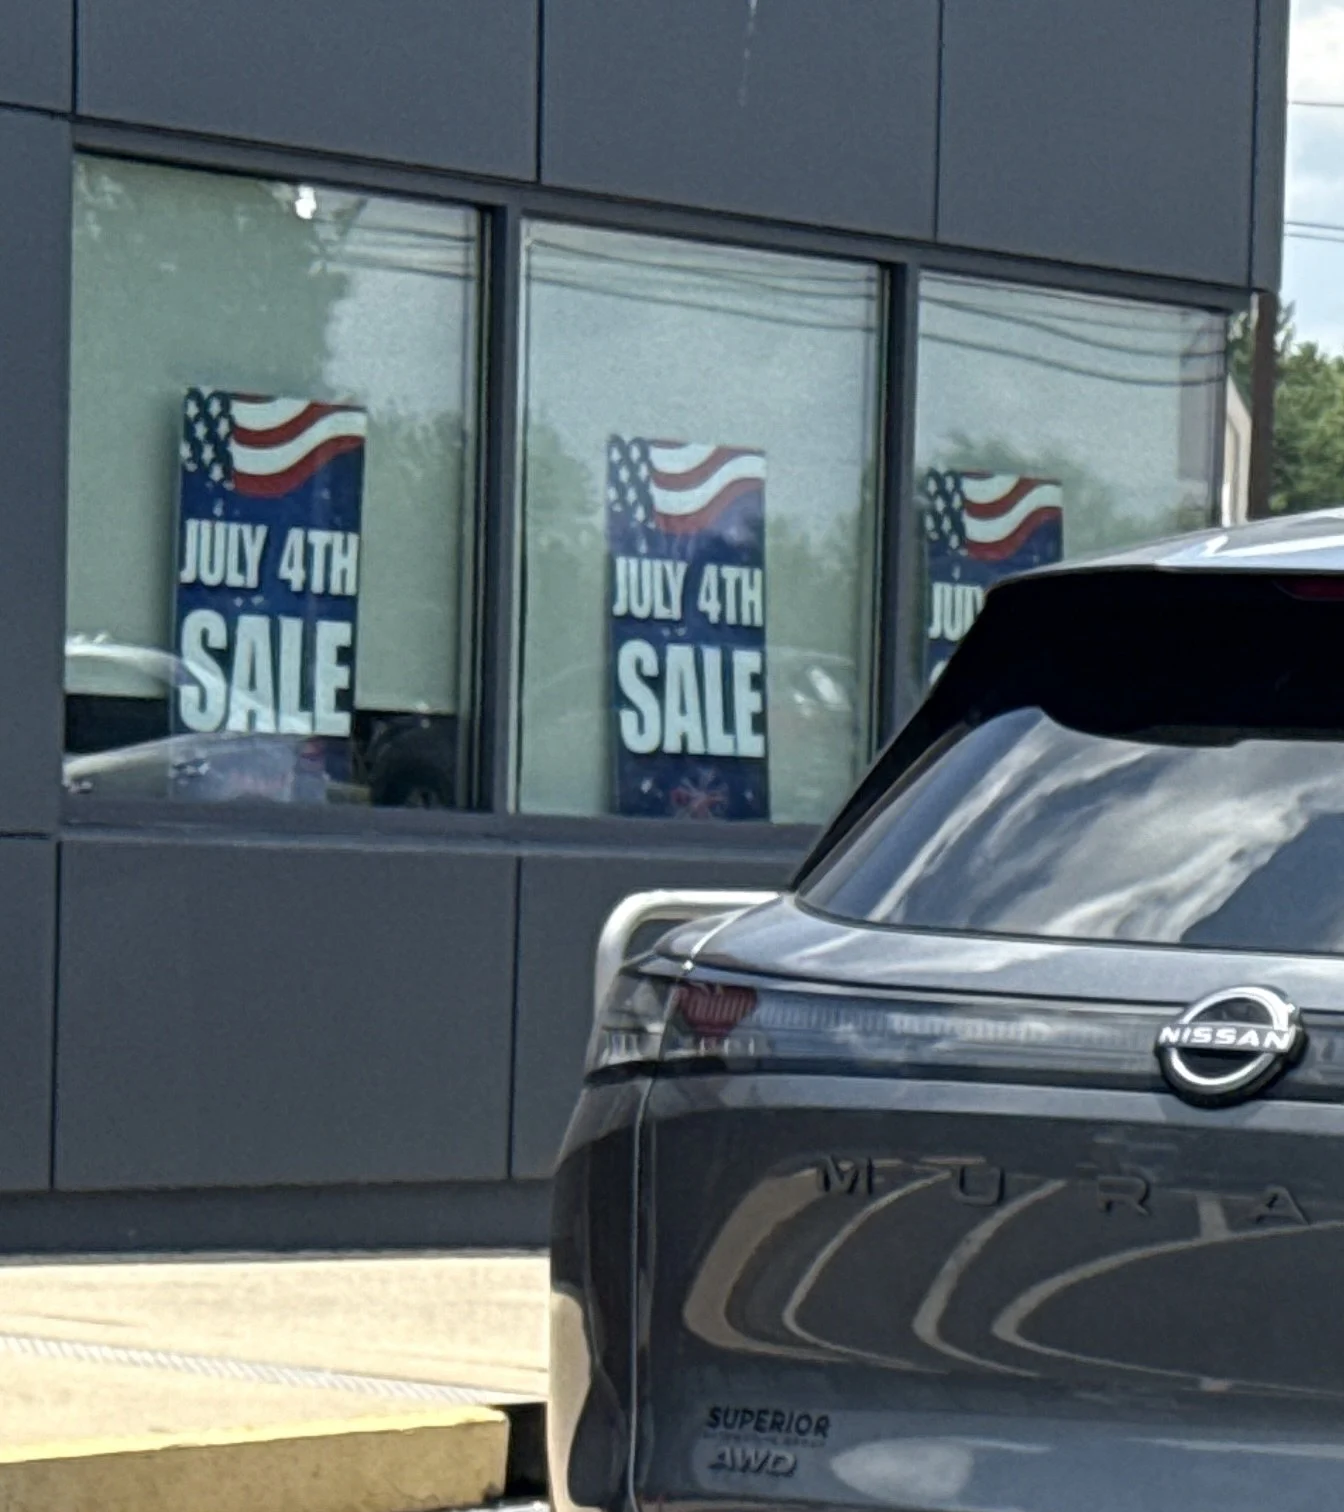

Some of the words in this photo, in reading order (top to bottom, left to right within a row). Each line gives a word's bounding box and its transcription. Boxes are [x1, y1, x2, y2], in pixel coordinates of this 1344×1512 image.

[180, 519, 268, 588] JULY
[278, 527, 360, 596] 4TH
[612, 557, 688, 620] JULY
[697, 566, 763, 628] 4TH
[180, 609, 353, 738] SALE
[617, 639, 766, 758] SALE
[1158, 1026, 1289, 1050] NISSAN
[706, 1405, 832, 1439] SUPERIOR
[707, 1447, 798, 1478] AWD
